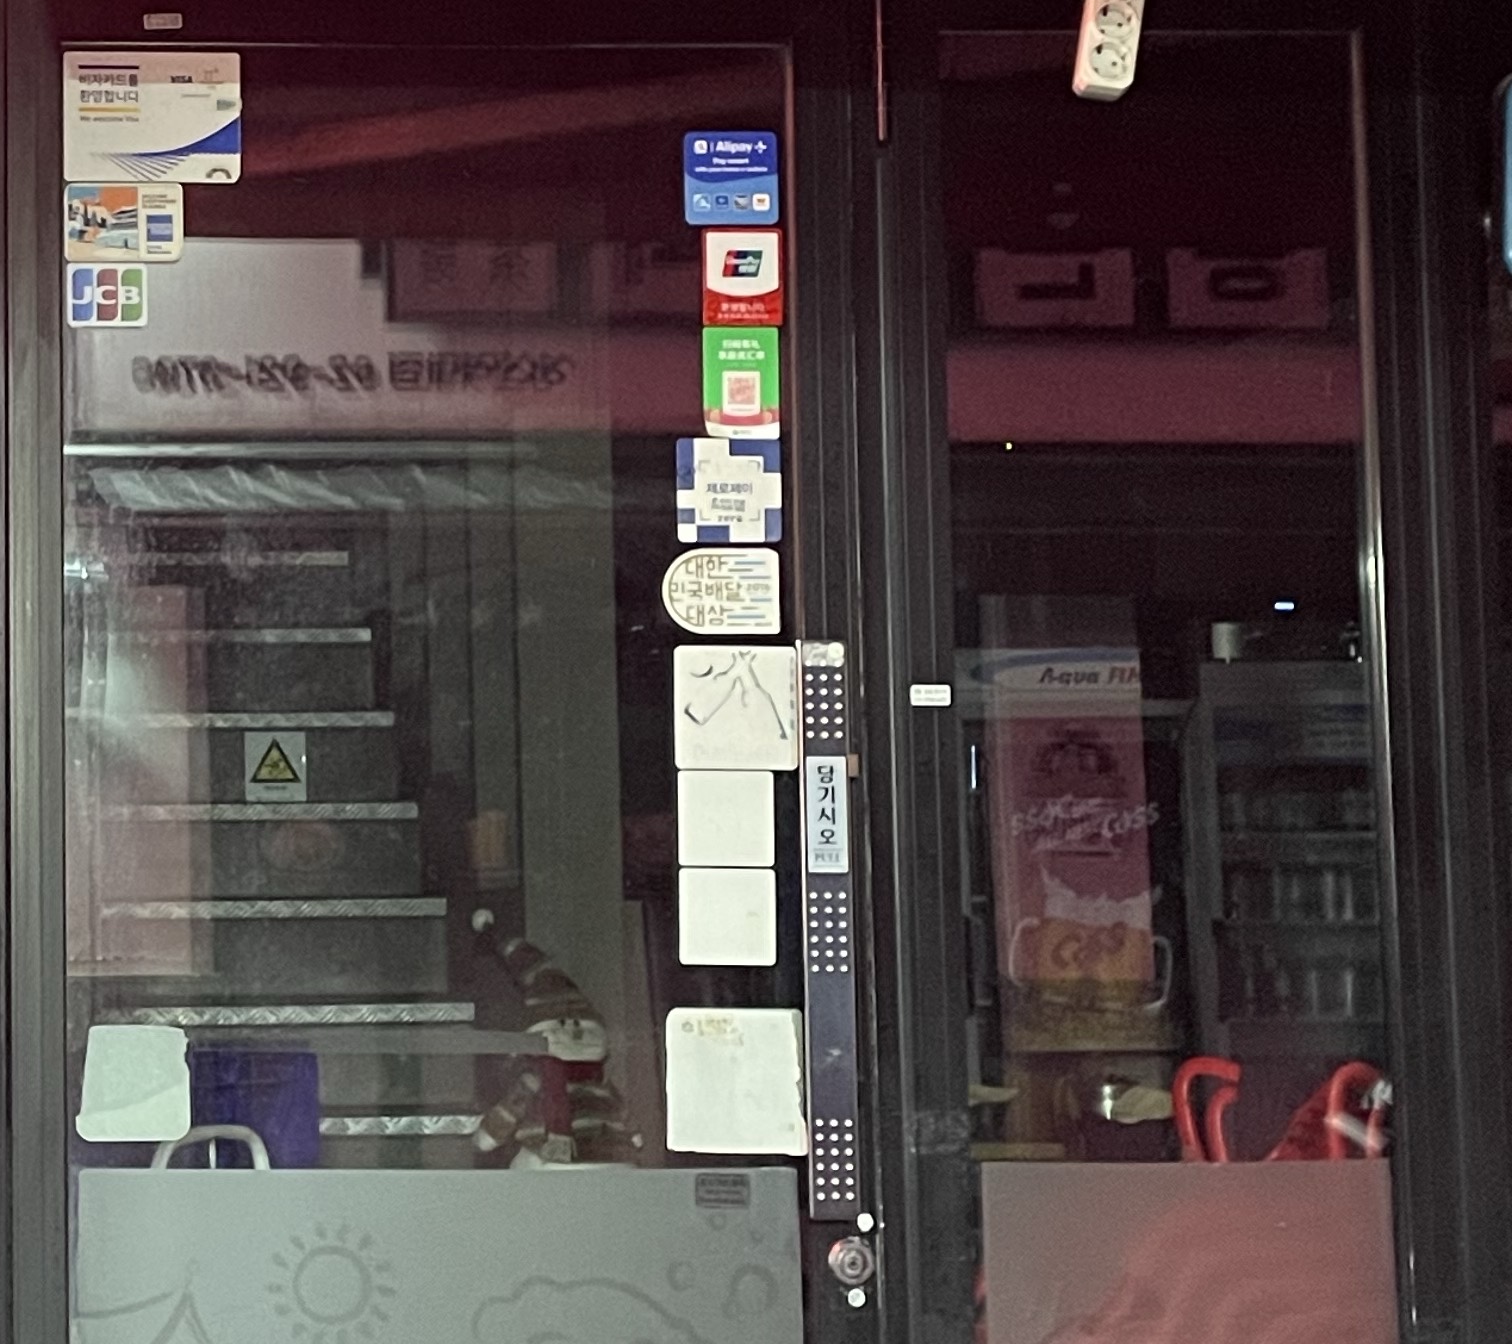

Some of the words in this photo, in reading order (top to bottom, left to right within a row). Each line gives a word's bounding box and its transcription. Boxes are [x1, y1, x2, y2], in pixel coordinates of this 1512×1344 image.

[72, 285, 141, 305] JCB
[685, 556, 730, 579] 대한
[685, 605, 735, 627] 대상
